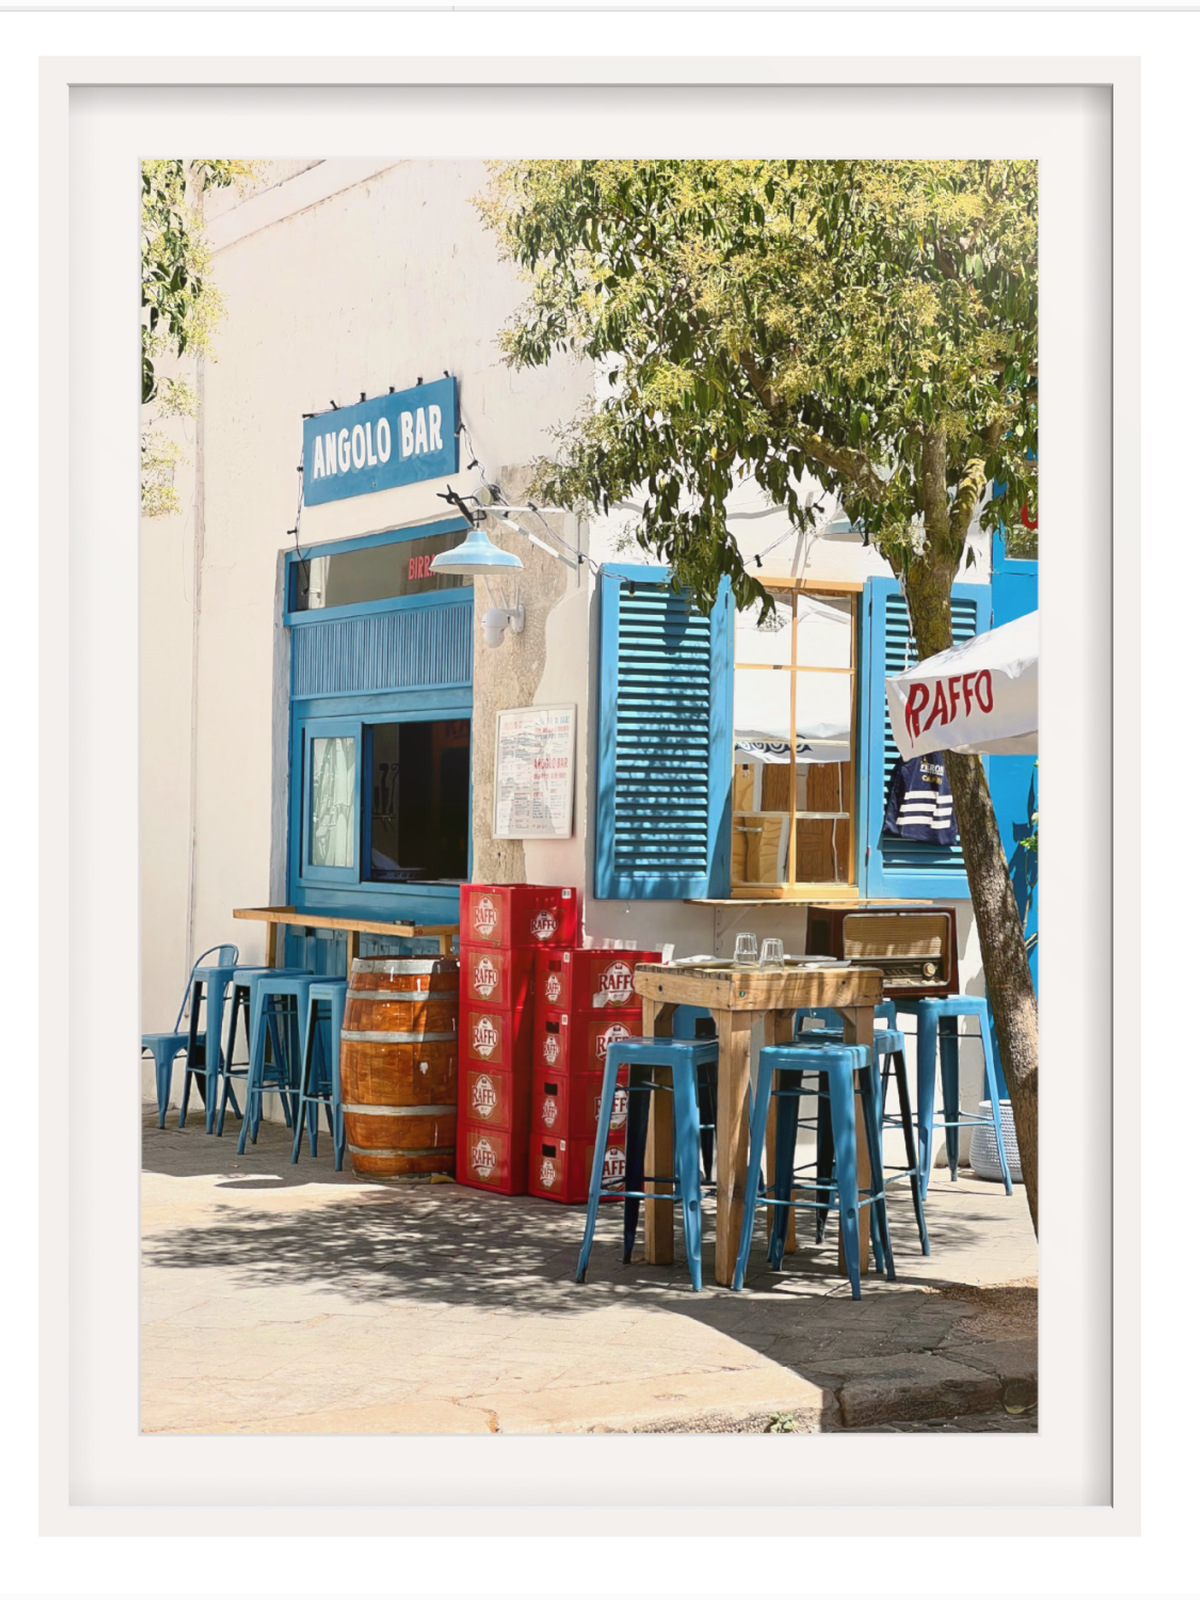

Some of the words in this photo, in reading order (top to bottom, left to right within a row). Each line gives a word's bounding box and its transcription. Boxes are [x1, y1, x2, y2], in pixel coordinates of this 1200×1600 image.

[312, 416, 392, 480] ANGOLO
[400, 404, 444, 458] BAR
[904, 669, 994, 749] RAFFO
[474, 907, 498, 925] RAFFO
[531, 919, 558, 932] RAFFO
[474, 967, 498, 985] RAFFO
[473, 1027, 497, 1045] RAFFO
[472, 1086, 497, 1105] RAFFO
[472, 1147, 497, 1167] RAFFO
